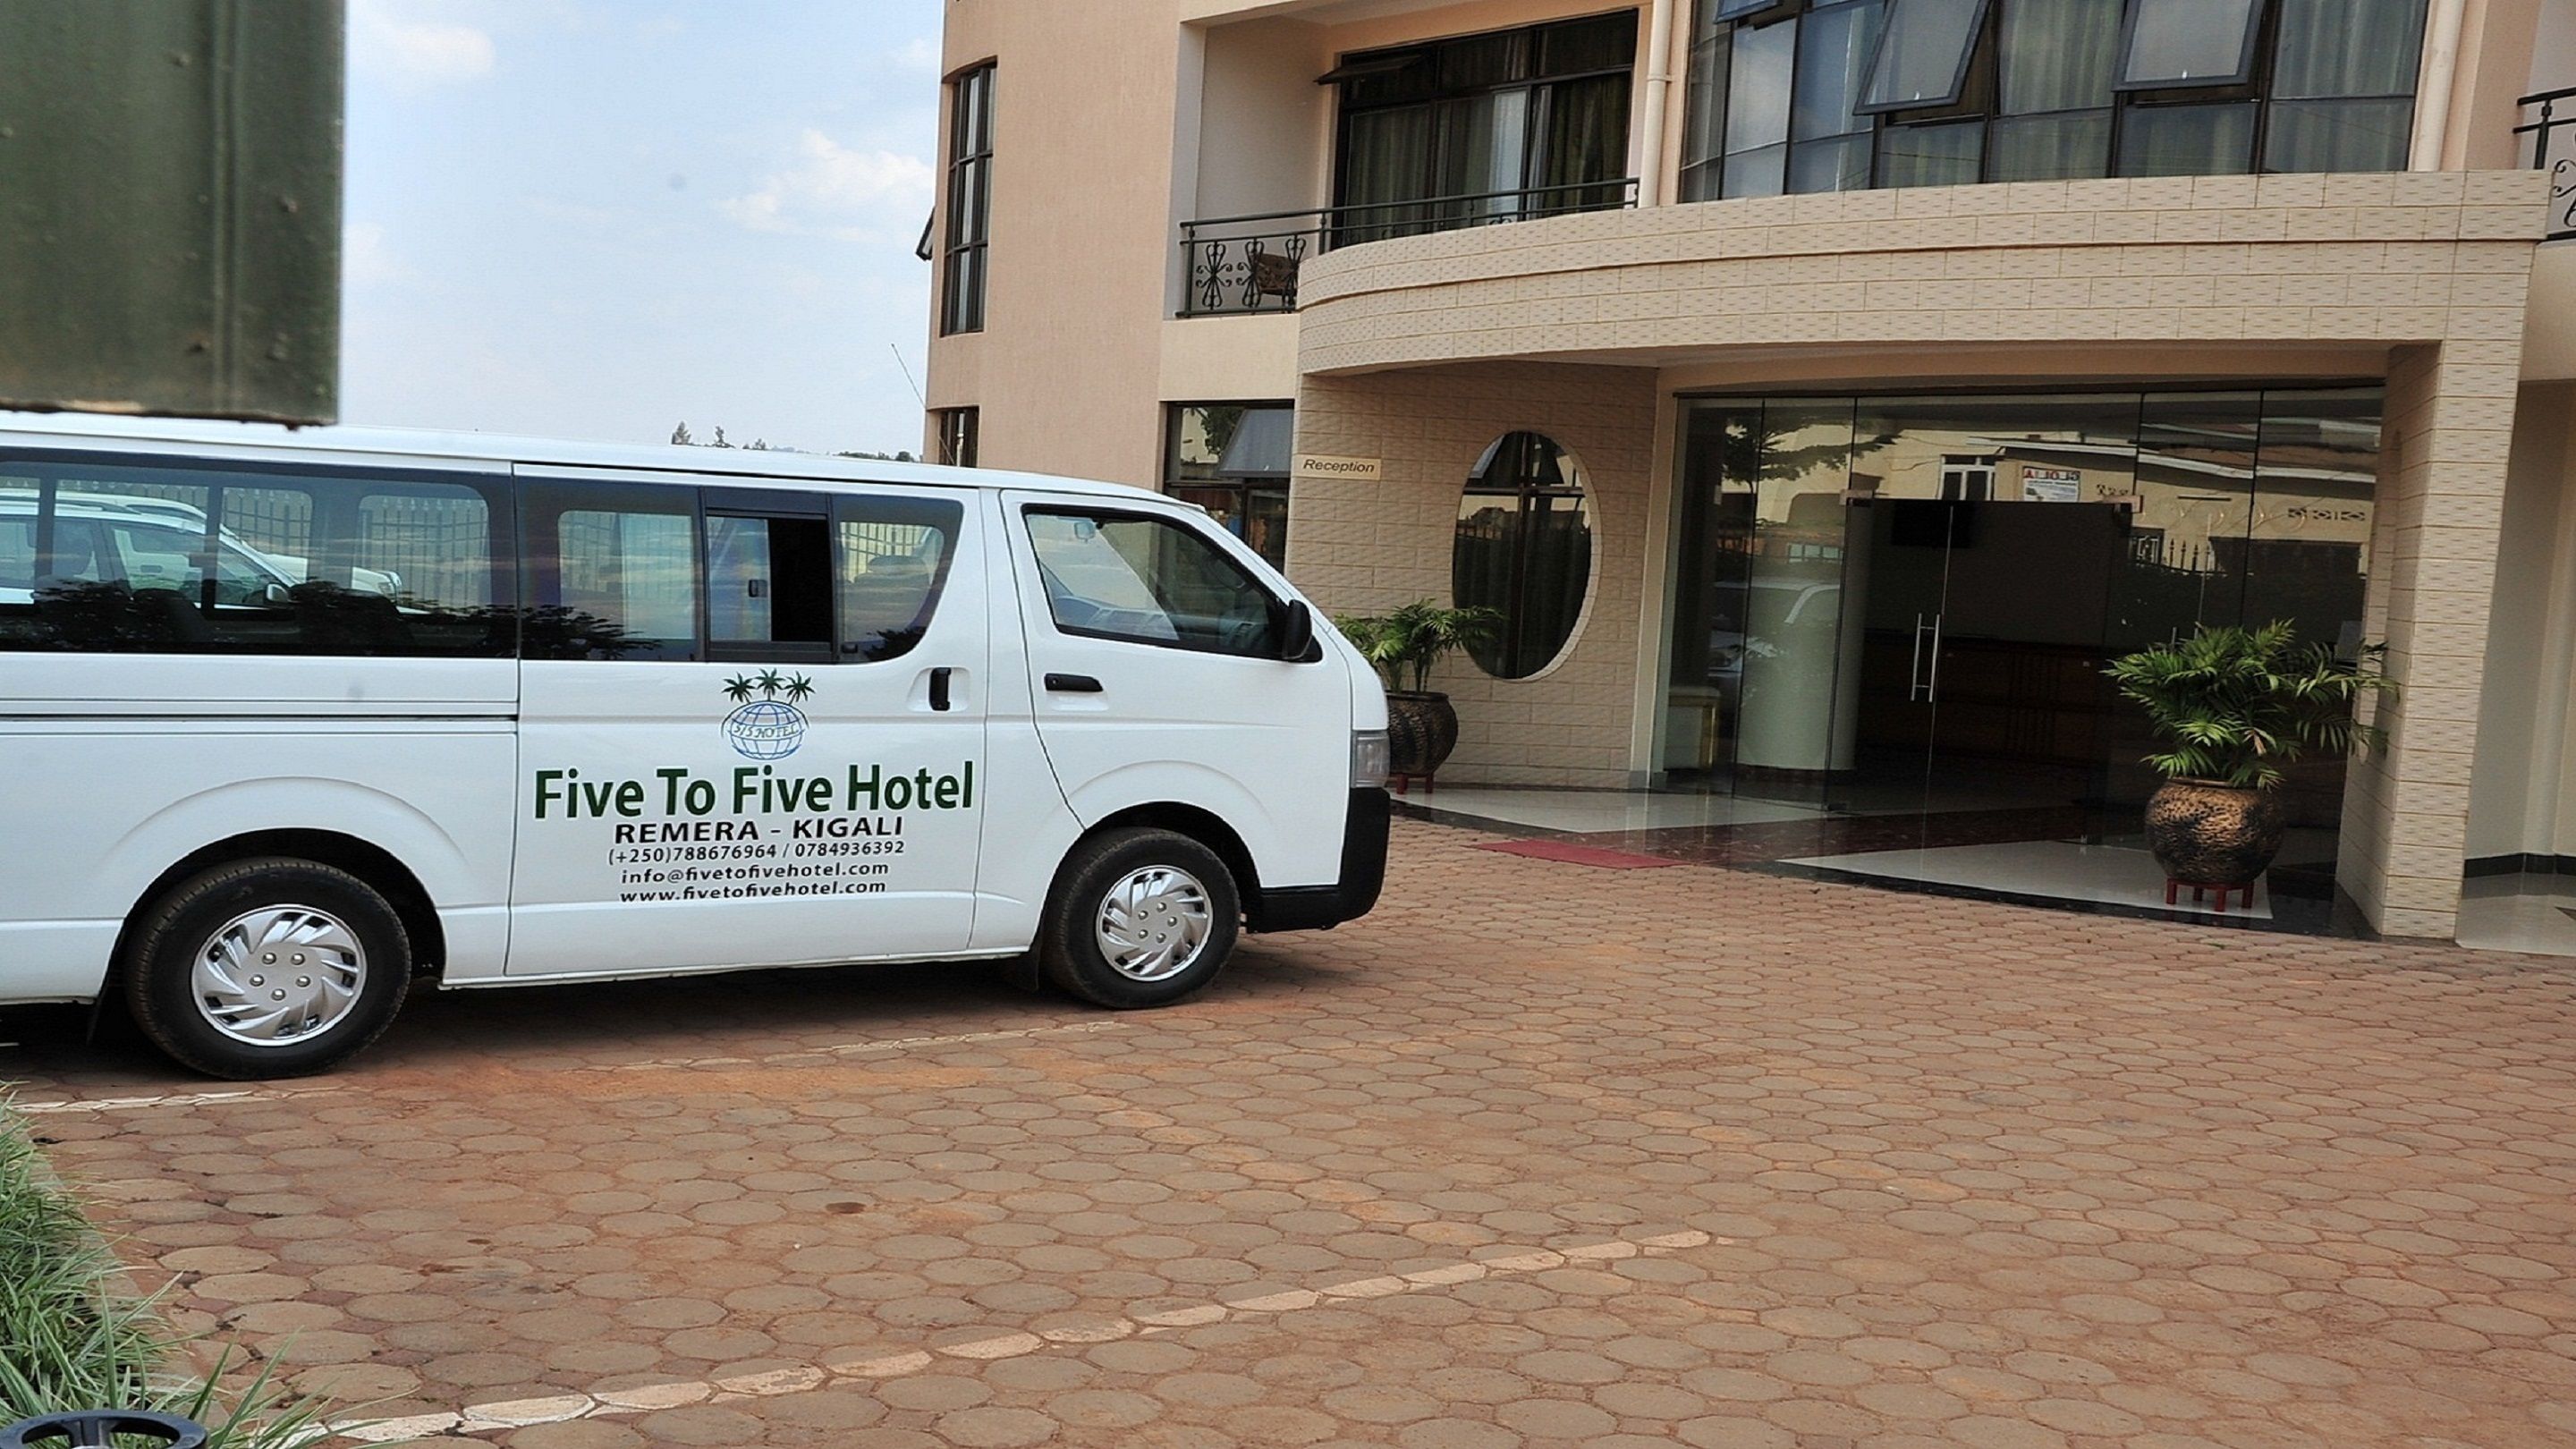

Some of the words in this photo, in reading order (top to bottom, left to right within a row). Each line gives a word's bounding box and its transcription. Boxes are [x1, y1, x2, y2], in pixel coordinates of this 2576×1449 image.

[1303, 459, 1375, 473] Reception
[754, 723, 799, 739] HOTEL
[535, 768, 644, 818] Five
[657, 768, 716, 815] To
[733, 765, 833, 813] Five
[848, 760, 973, 810] Hotel
[614, 821, 759, 844] REMERA
[793, 817, 903, 839] KIGALI
[608, 844, 776, 865] (+250)788676964
[782, 843, 790, 858] /
[794, 841, 904, 858] 0784936392
[622, 862, 889, 884] info@fivetofivehotel.com
[620, 881, 886, 902] www.fivetofivehotel.com
